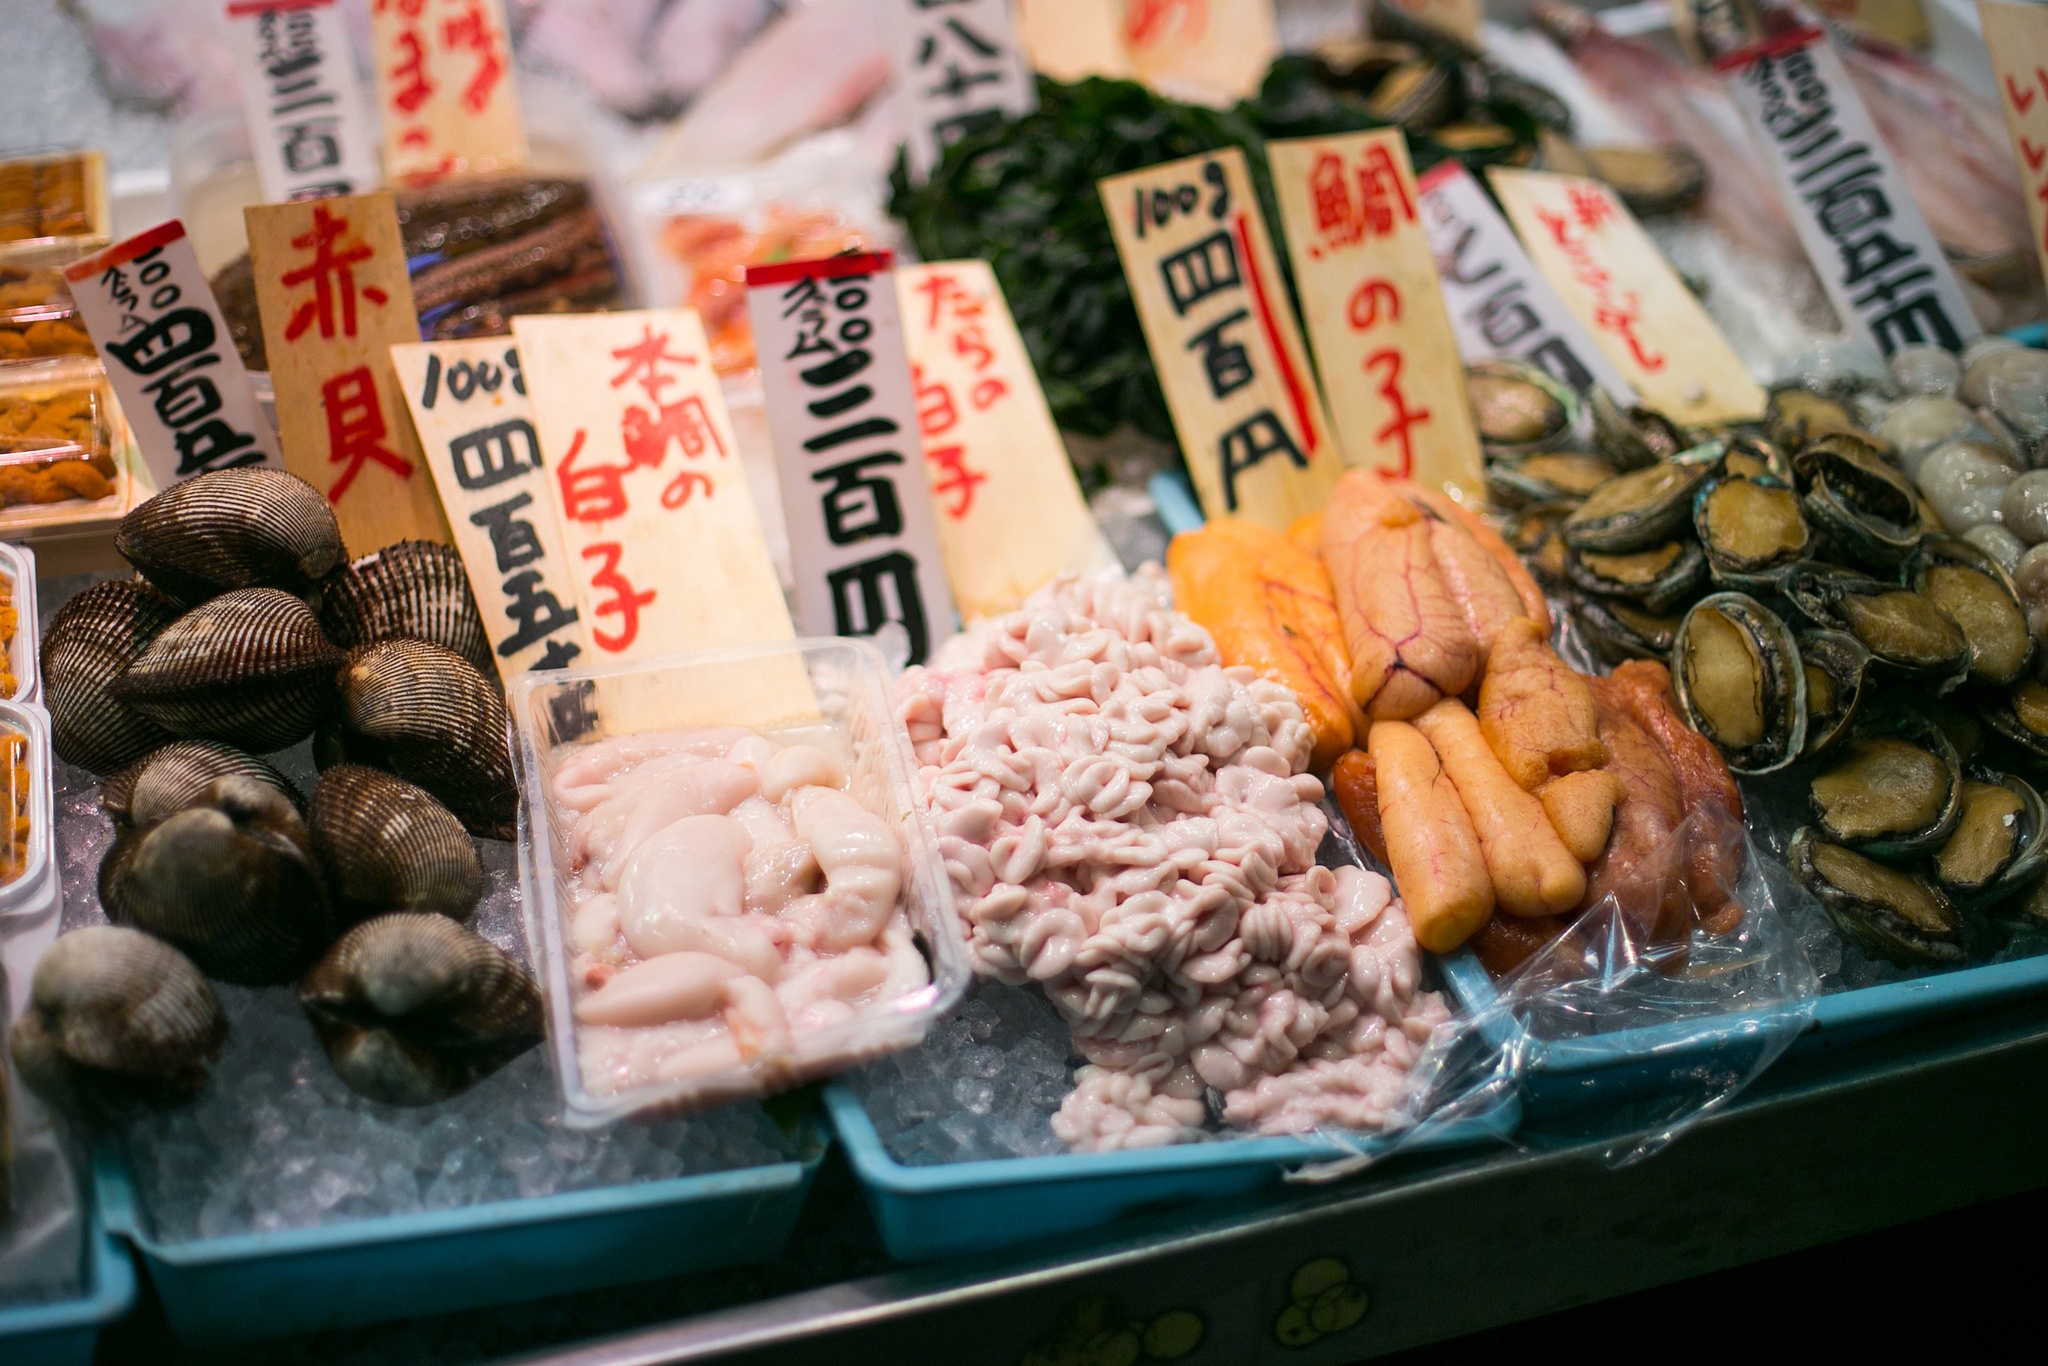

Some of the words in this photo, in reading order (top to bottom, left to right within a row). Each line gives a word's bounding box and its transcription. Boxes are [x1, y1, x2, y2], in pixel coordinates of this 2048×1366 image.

[281, 206, 413, 505] 赤貝
[913, 274, 1010, 412] たらの
[1160, 228, 1310, 512] 四百円
[1305, 144, 1431, 482] 鯛の子
[556, 428, 658, 654] 白子
